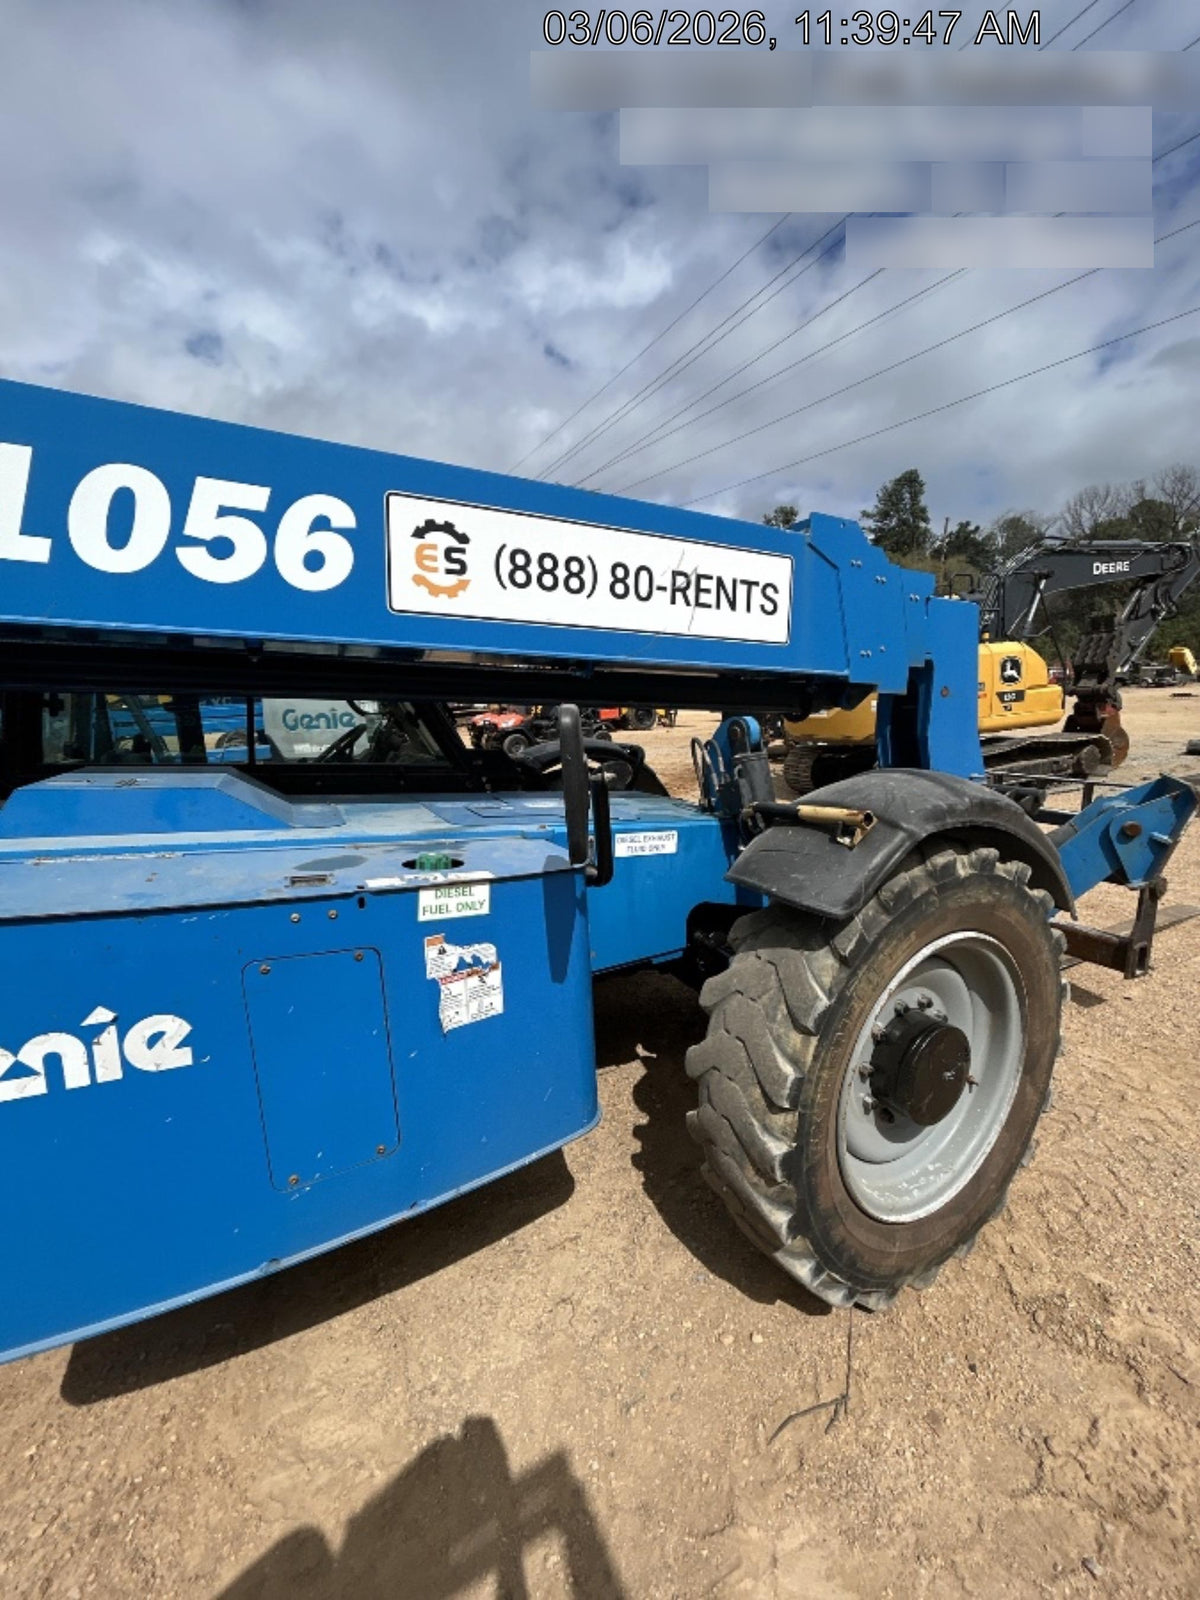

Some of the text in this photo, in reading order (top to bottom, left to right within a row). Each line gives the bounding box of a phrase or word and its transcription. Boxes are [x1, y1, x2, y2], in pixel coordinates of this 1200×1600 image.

[1092, 561, 1130, 575] DEERE
[494, 543, 780, 616] (888) 80-RENTS
[281, 707, 357, 731] Genie
[434, 885, 475, 899] DIESEL
[422, 899, 486, 916] FUEL ONLY
